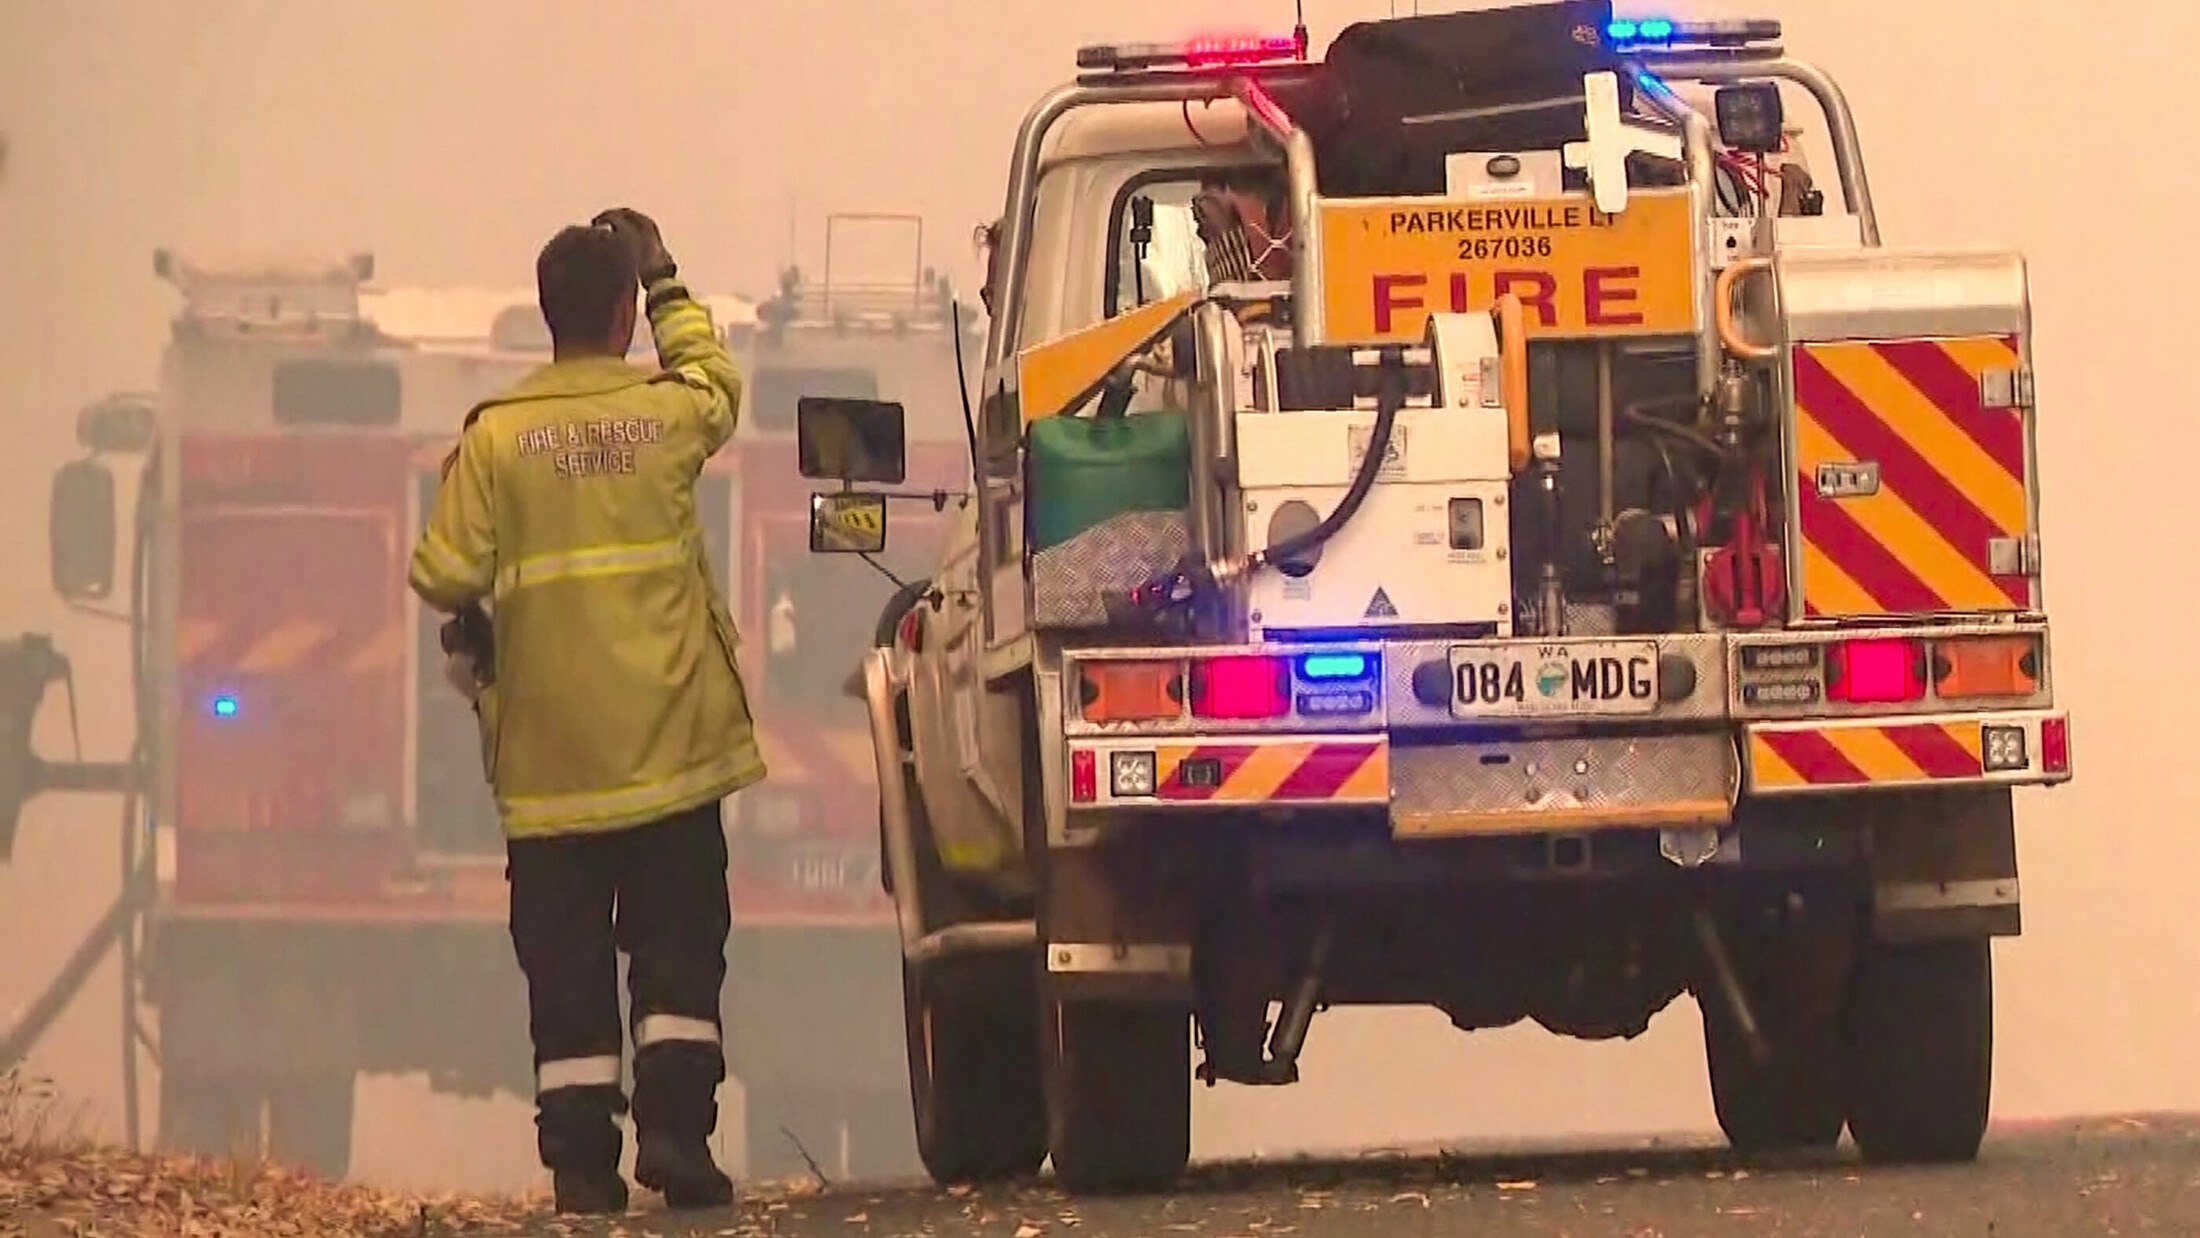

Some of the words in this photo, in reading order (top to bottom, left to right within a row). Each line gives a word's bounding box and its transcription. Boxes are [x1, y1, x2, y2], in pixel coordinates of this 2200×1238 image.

[1390, 207, 1580, 233] PARKERVILLE
[1458, 237, 1552, 259] 267036
[1372, 267, 1643, 333] FIRE
[517, 425, 560, 456] FIRE
[566, 422, 581, 448] &
[586, 418, 663, 446] RESCUE
[554, 451, 635, 476] SERVICE
[1537, 646, 1569, 659] WA
[1457, 661, 1525, 704] 084
[1571, 657, 1651, 701] MDG
